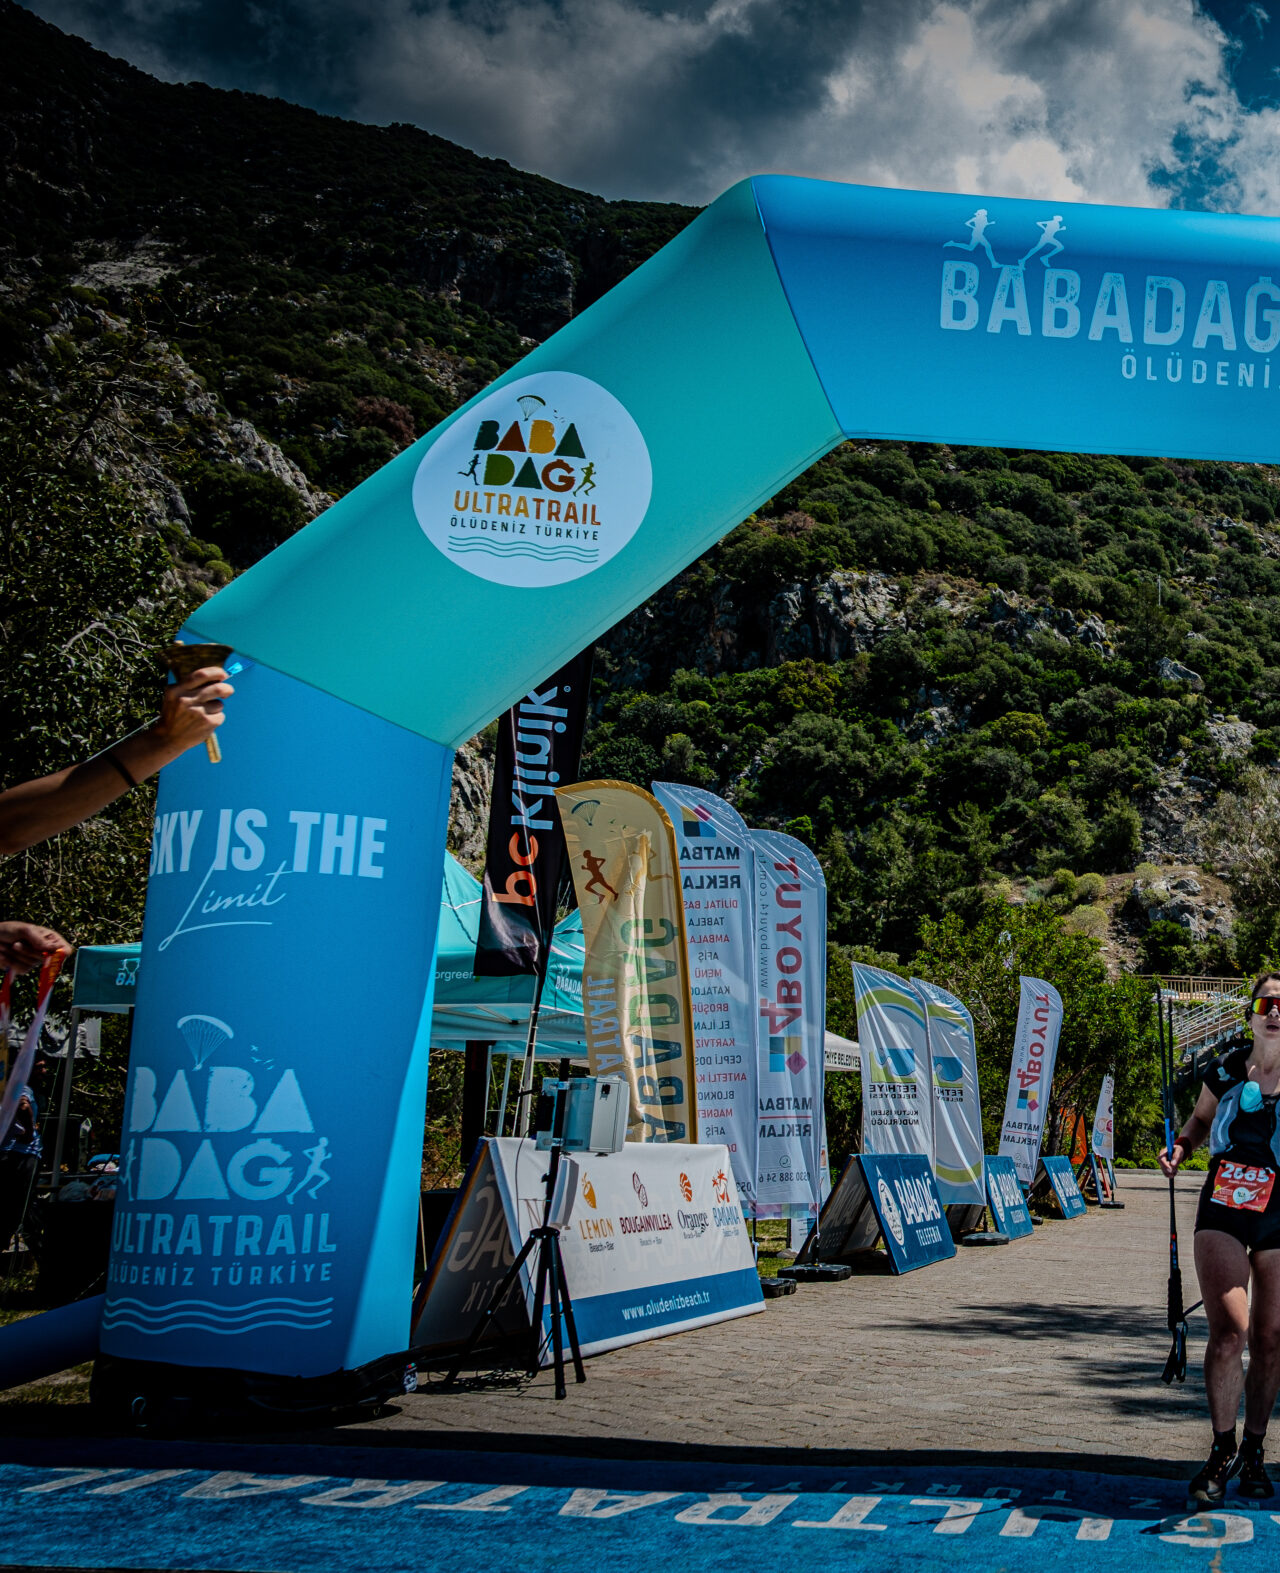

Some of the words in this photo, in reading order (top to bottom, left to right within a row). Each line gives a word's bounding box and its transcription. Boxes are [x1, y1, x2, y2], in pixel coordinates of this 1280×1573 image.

[472, 419, 586, 459] BABA
[483, 453, 576, 493] DAĞ
[450, 514, 526, 534] ÖLÜDENİZ
[535, 523, 599, 541] TÜRKİYE
[454, 490, 601, 526] ULTRATRAIL
[149, 810, 203, 878] SKY
[214, 808, 268, 873] IS
[288, 810, 387, 879] THE
[157, 860, 293, 951] Limit
[129, 1066, 315, 1134] BABA
[136, 1137, 296, 1201] DAĞ
[113, 1212, 337, 1257] ULTRATRAIL
[579, 1218, 614, 1240] LEMON
[619, 1213, 673, 1235] BOUGAINVILLEA
[211, 1260, 333, 1286] TÜRKİYE
[622, 1291, 711, 1320] www.oludenizbeach.tr
